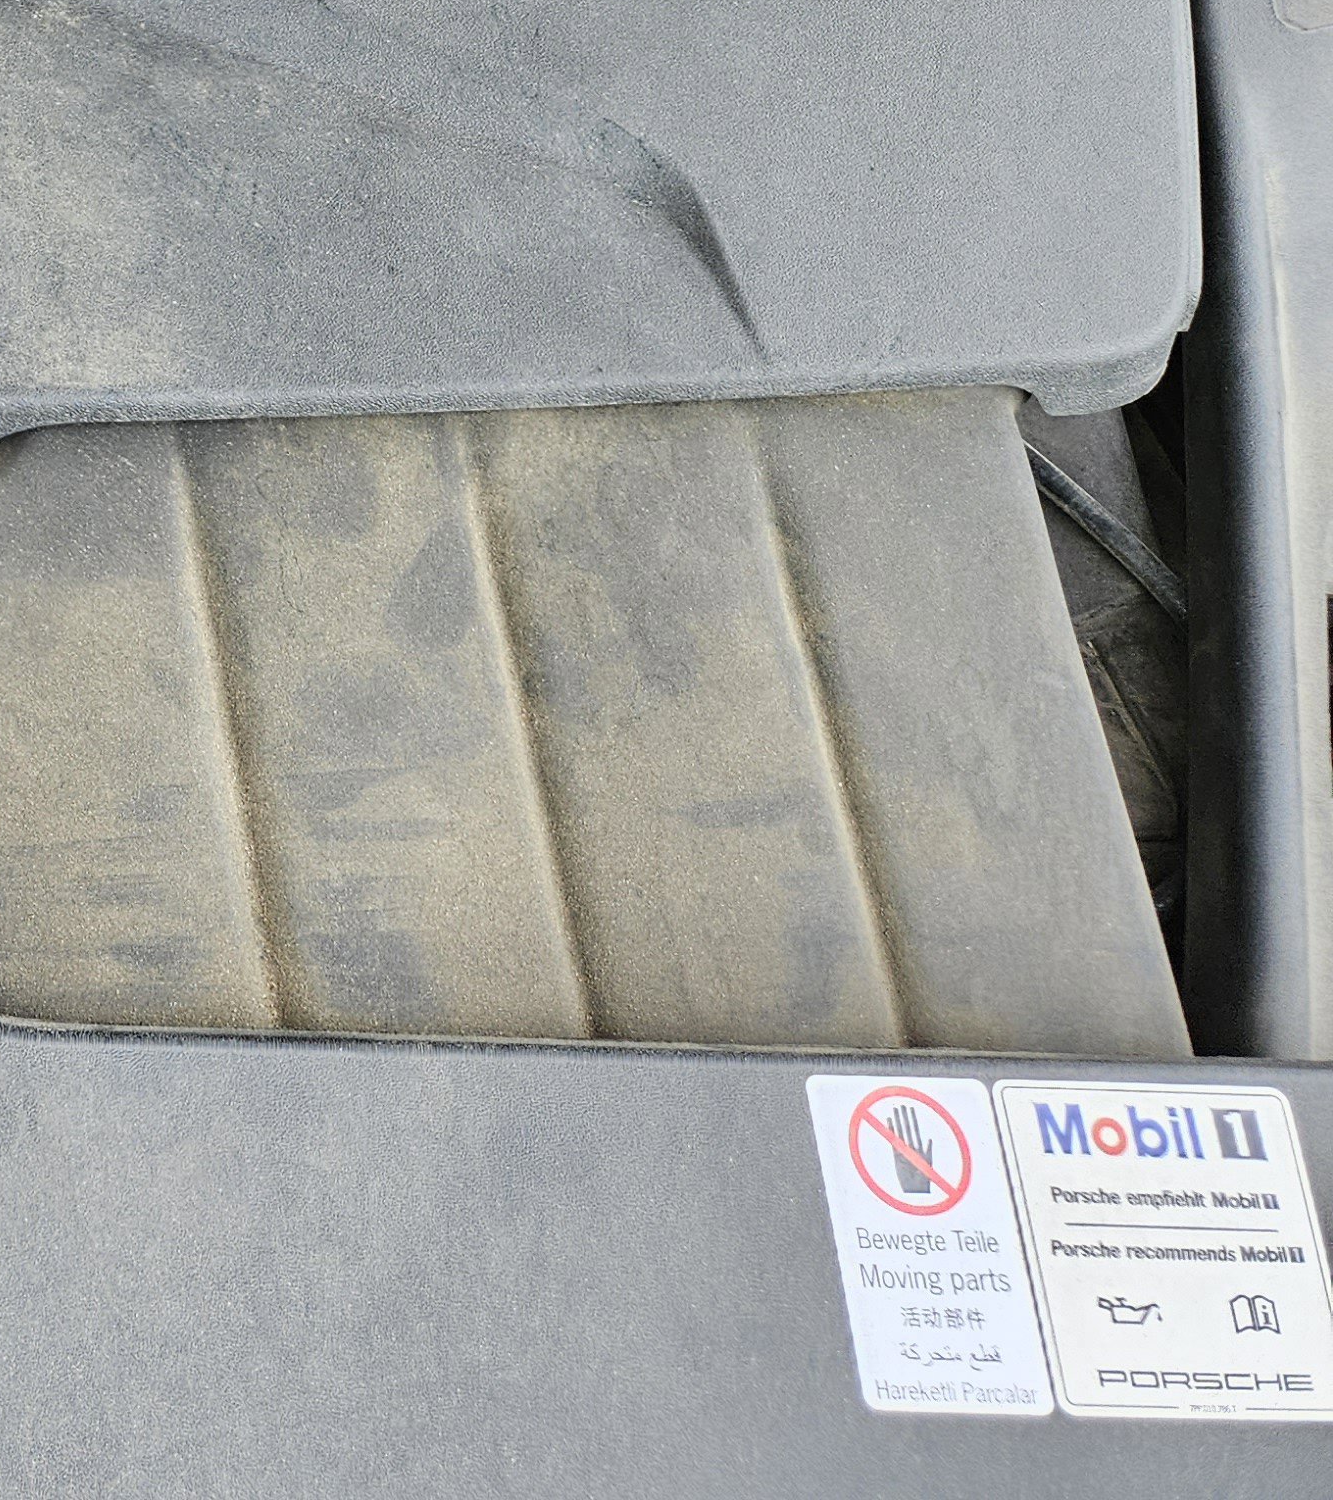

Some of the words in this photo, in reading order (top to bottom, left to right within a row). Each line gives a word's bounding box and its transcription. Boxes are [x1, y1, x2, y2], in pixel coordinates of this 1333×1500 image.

[1033, 1102, 1206, 1160] Mobil
[1050, 1186, 1121, 1207] Porsche
[1126, 1190, 1207, 1210] empfiehlt
[1212, 1191, 1261, 1210] Mobil
[856, 1227, 946, 1255] Bewegte
[951, 1230, 1000, 1253] Teile
[1051, 1239, 1121, 1260] Porsche
[1126, 1244, 1237, 1263] recommends
[1239, 1245, 1288, 1263] Mobil
[859, 1263, 944, 1295] Moving
[950, 1268, 1013, 1295] parts
[900, 1306, 986, 1330] 活动部件
[875, 1379, 958, 1403] Hareketli
[1097, 1369, 1315, 1392] PORSCHE
